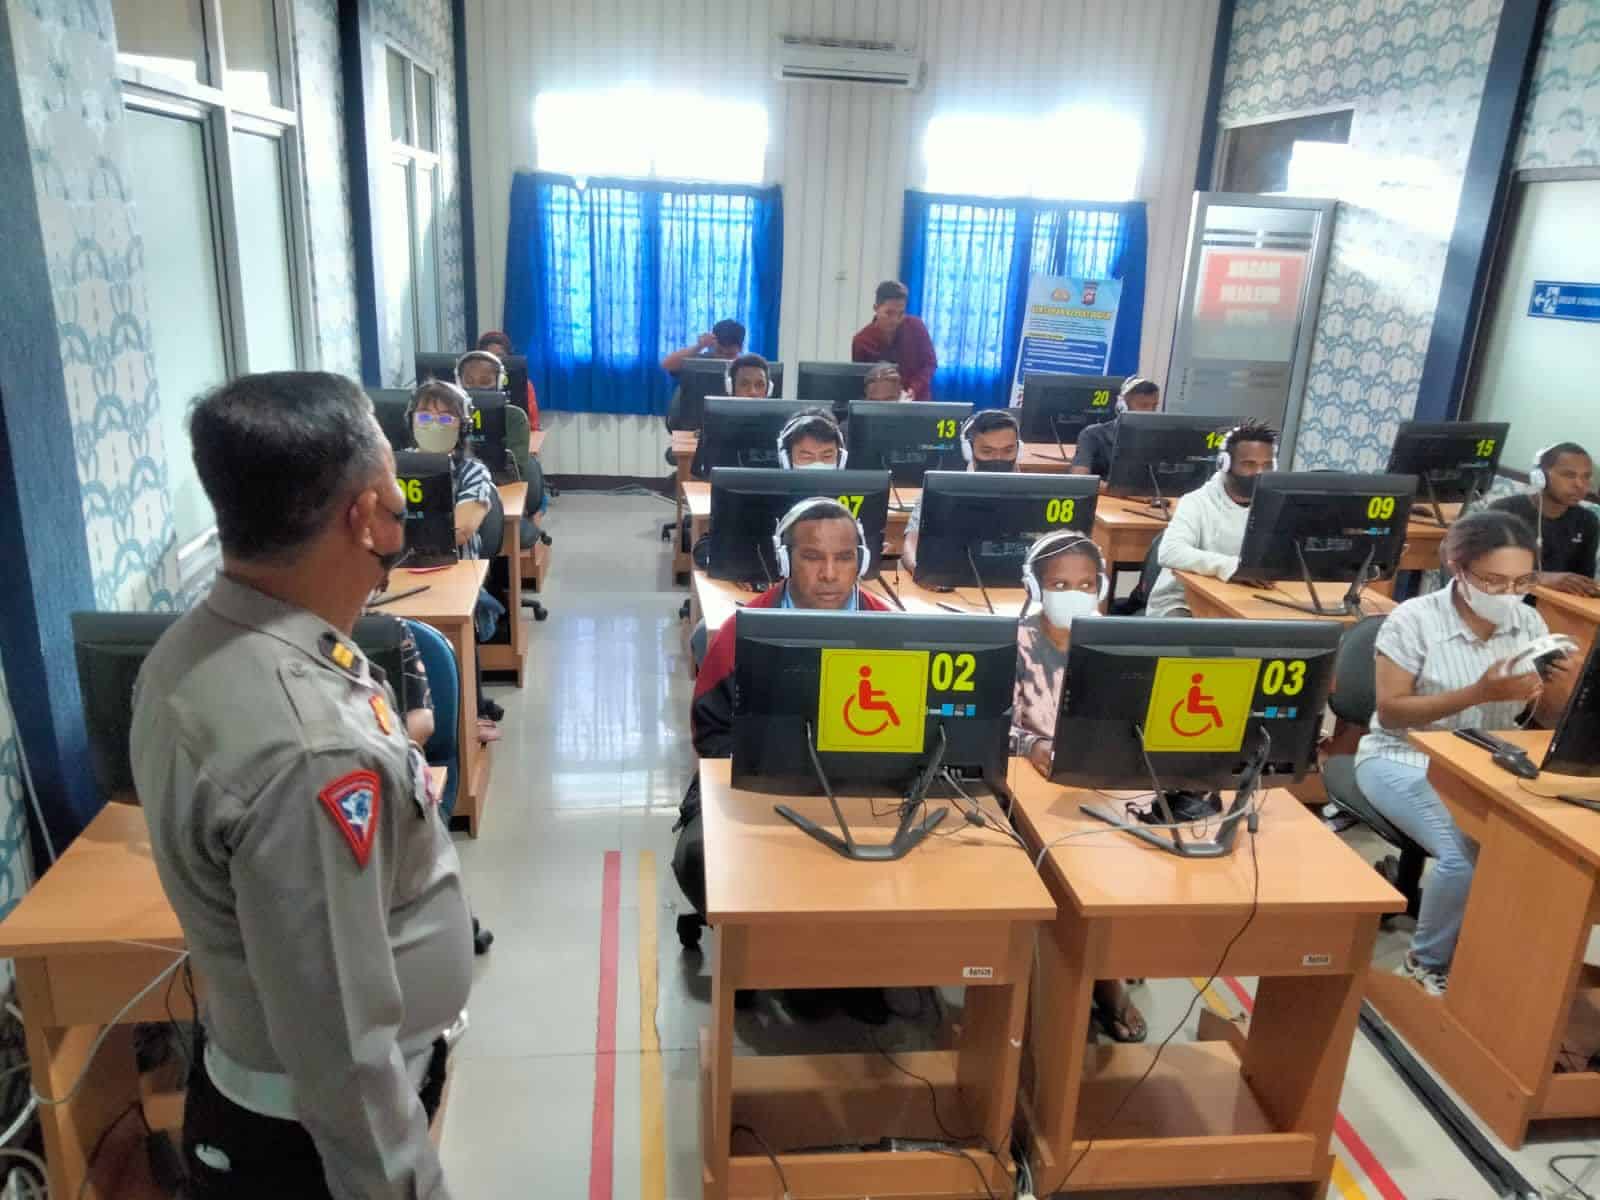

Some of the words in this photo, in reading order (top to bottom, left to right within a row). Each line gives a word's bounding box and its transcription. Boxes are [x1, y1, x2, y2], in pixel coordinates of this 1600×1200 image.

[1092, 390, 1110, 406] 20
[936, 419, 957, 438] 13
[1476, 440, 1496, 456] 15
[1046, 498, 1075, 523] 08
[1367, 496, 1395, 520] 09
[931, 652, 976, 691] 02
[1262, 660, 1306, 696] 03
